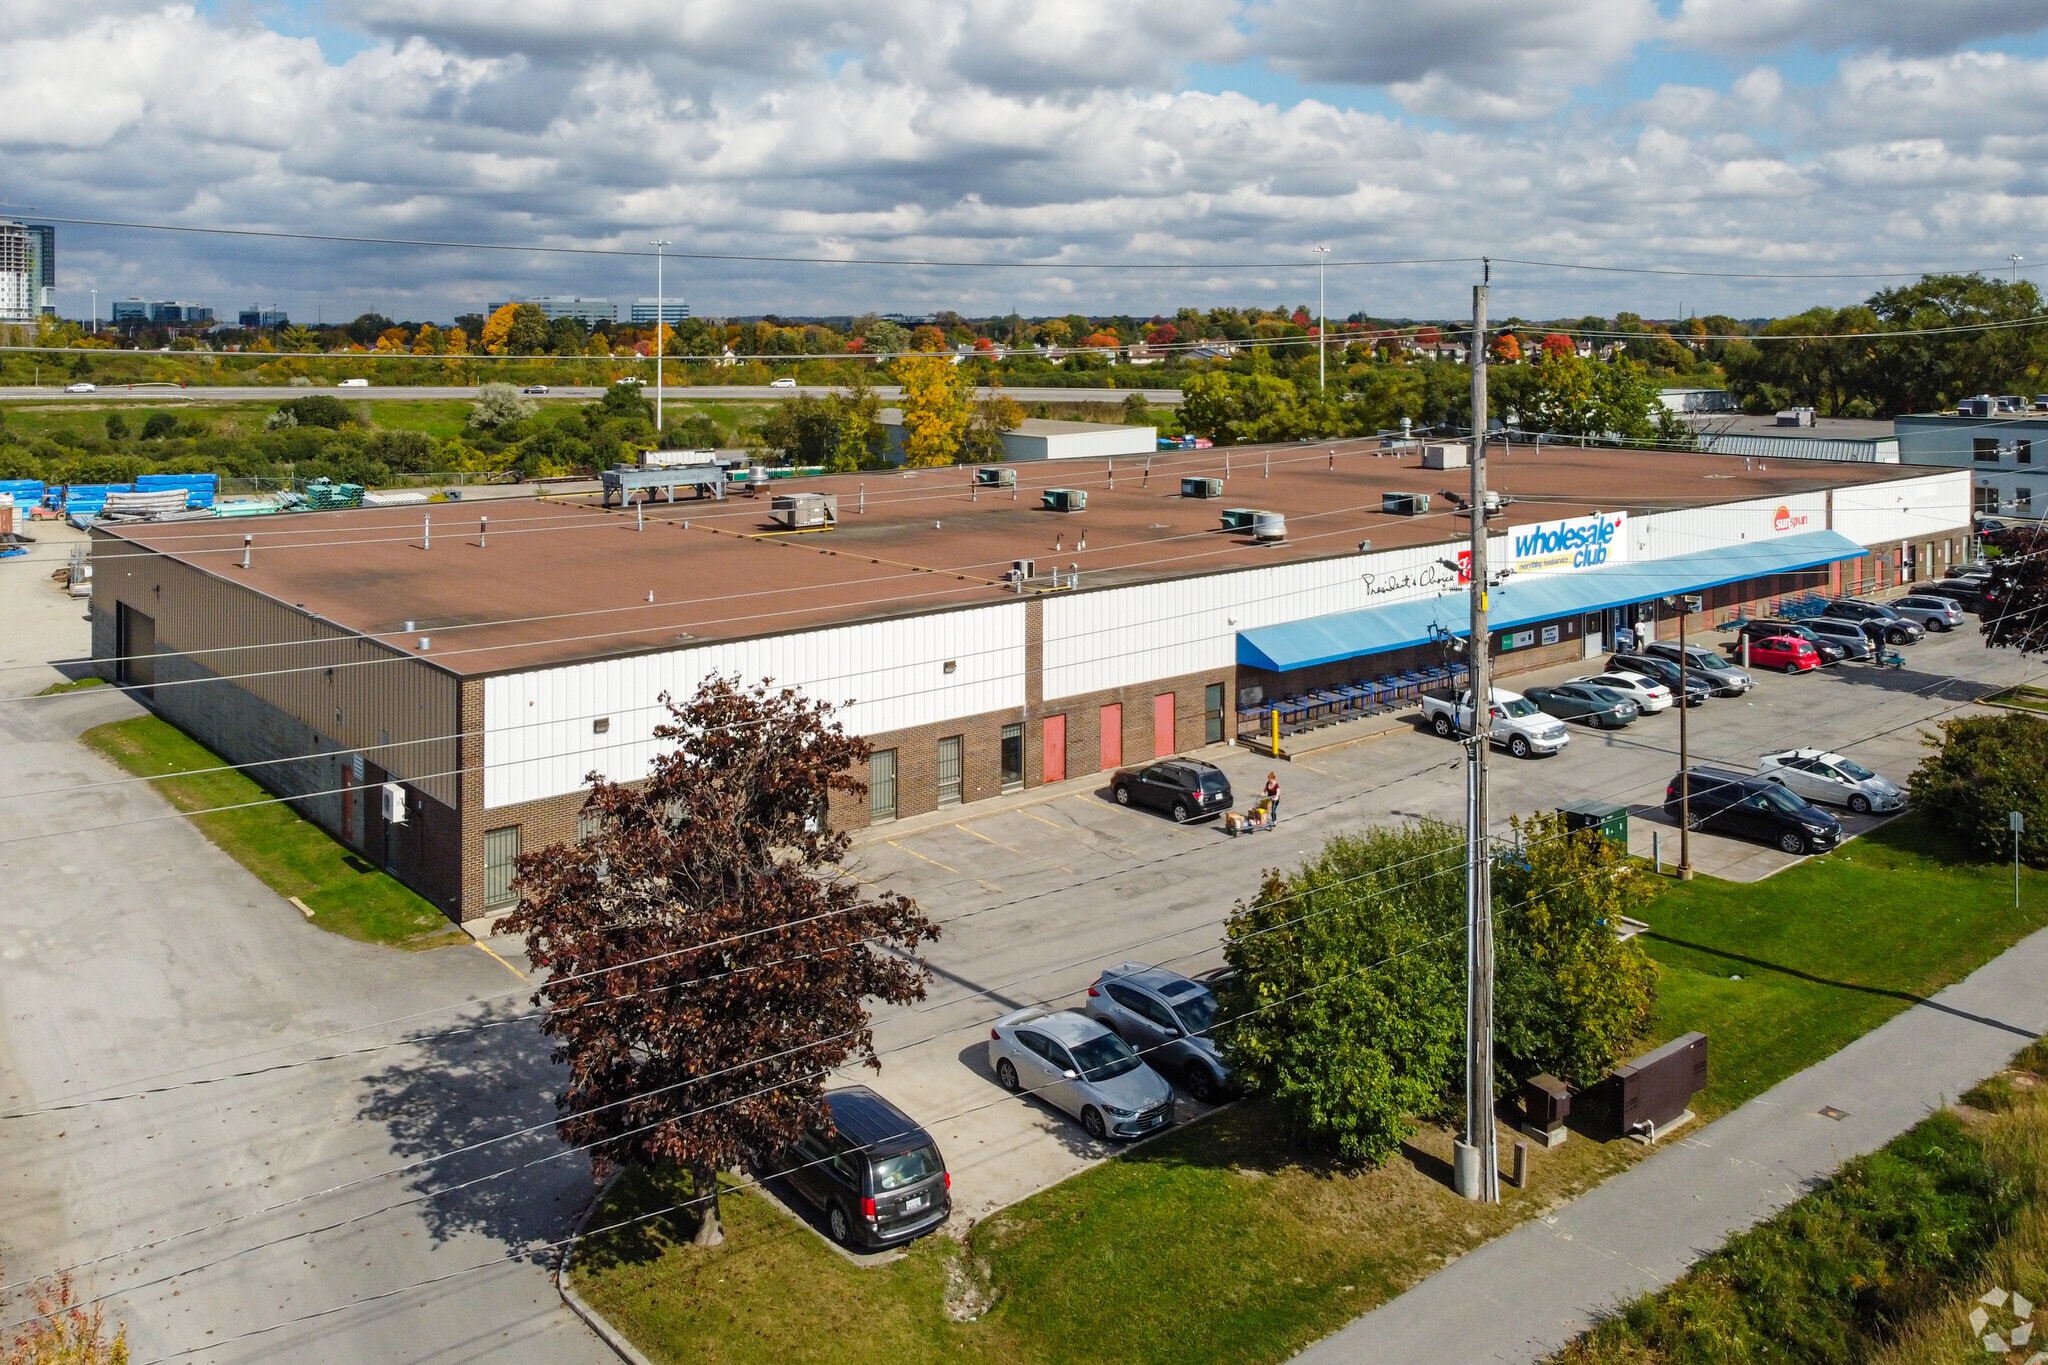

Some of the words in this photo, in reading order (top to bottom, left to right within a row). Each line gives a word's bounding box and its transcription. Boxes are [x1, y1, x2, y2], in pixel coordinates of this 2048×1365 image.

[1515, 516, 1615, 558] wholesale
[1573, 541, 1607, 568] club
[1362, 573, 1416, 595] President's
[1419, 566, 1455, 587] Choice
